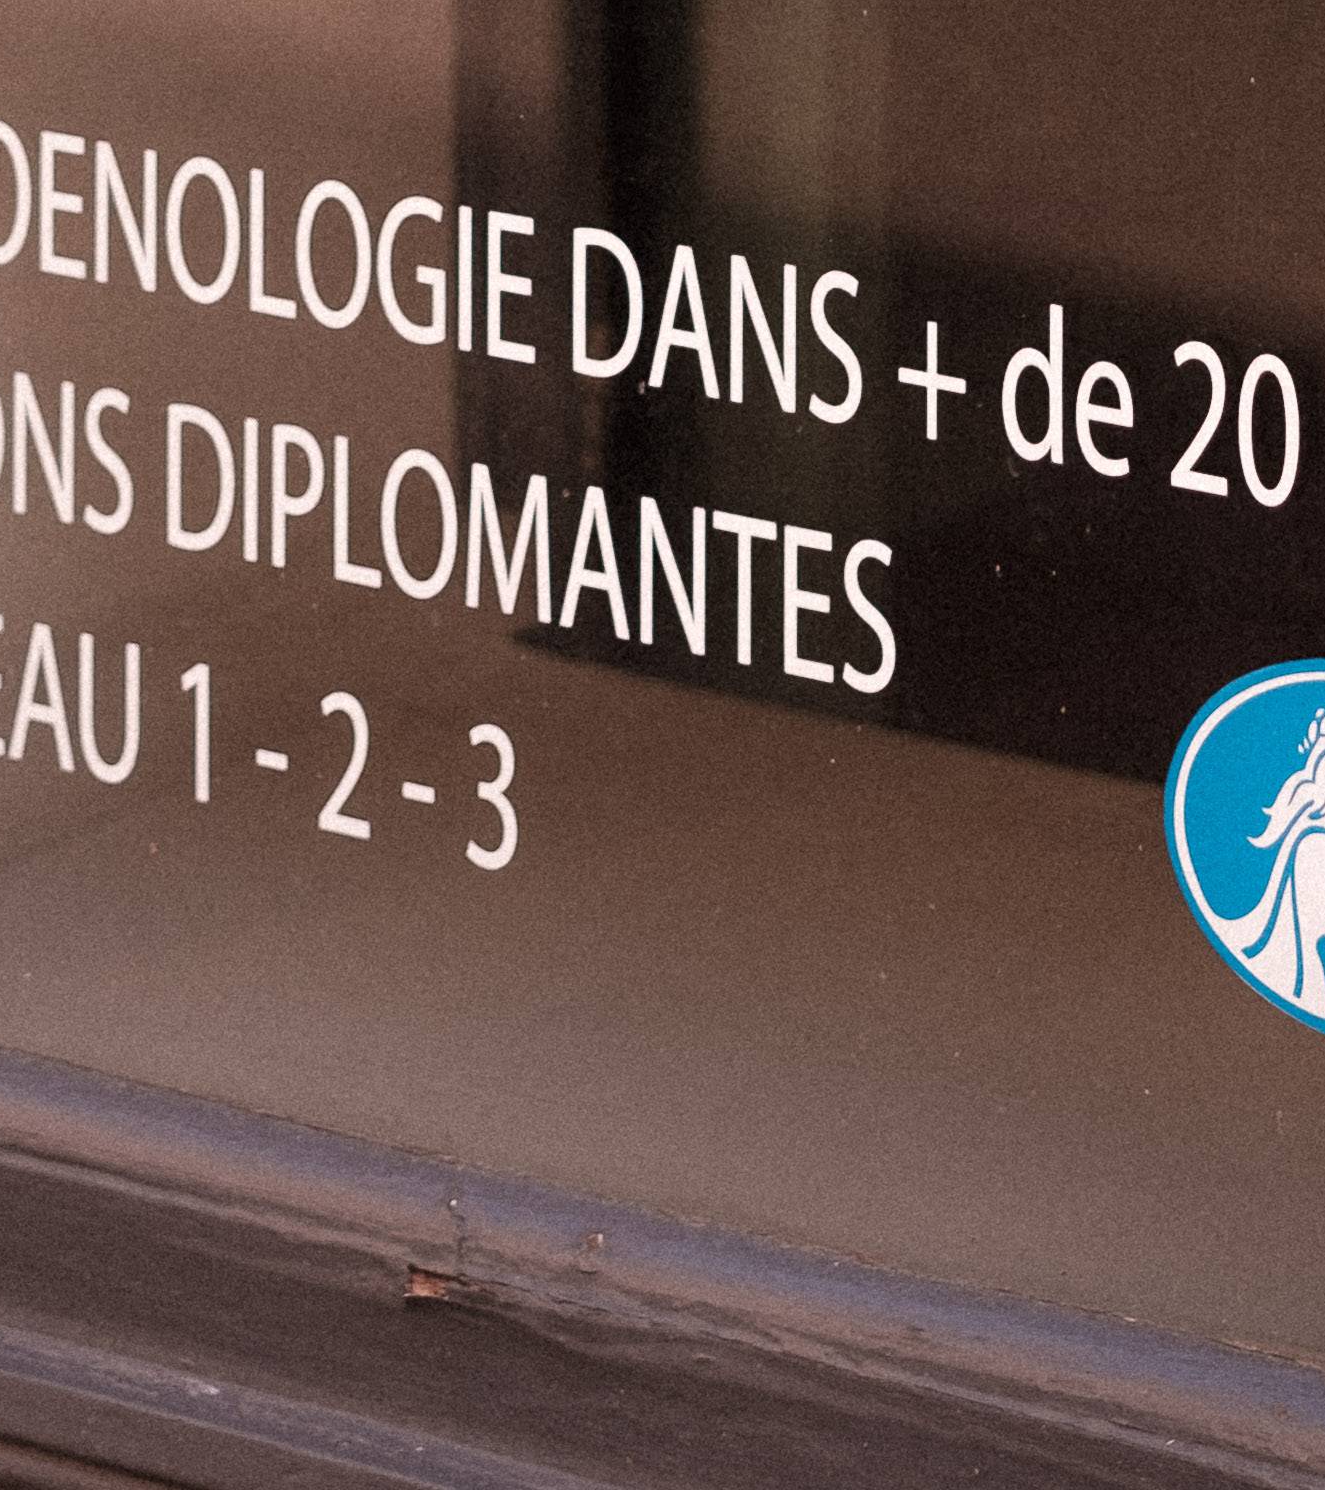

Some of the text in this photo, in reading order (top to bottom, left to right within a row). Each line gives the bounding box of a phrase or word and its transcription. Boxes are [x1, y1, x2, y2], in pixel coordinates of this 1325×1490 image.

[570, 225, 864, 426] DANS
[897, 320, 966, 442] +
[1001, 303, 1135, 477] de
[1170, 340, 1301, 508] 20
[164, 402, 897, 694] DIPLOMANTES
[179, 662, 212, 803] 1
[317, 690, 371, 841] 2
[465, 723, 519, 871] 3
